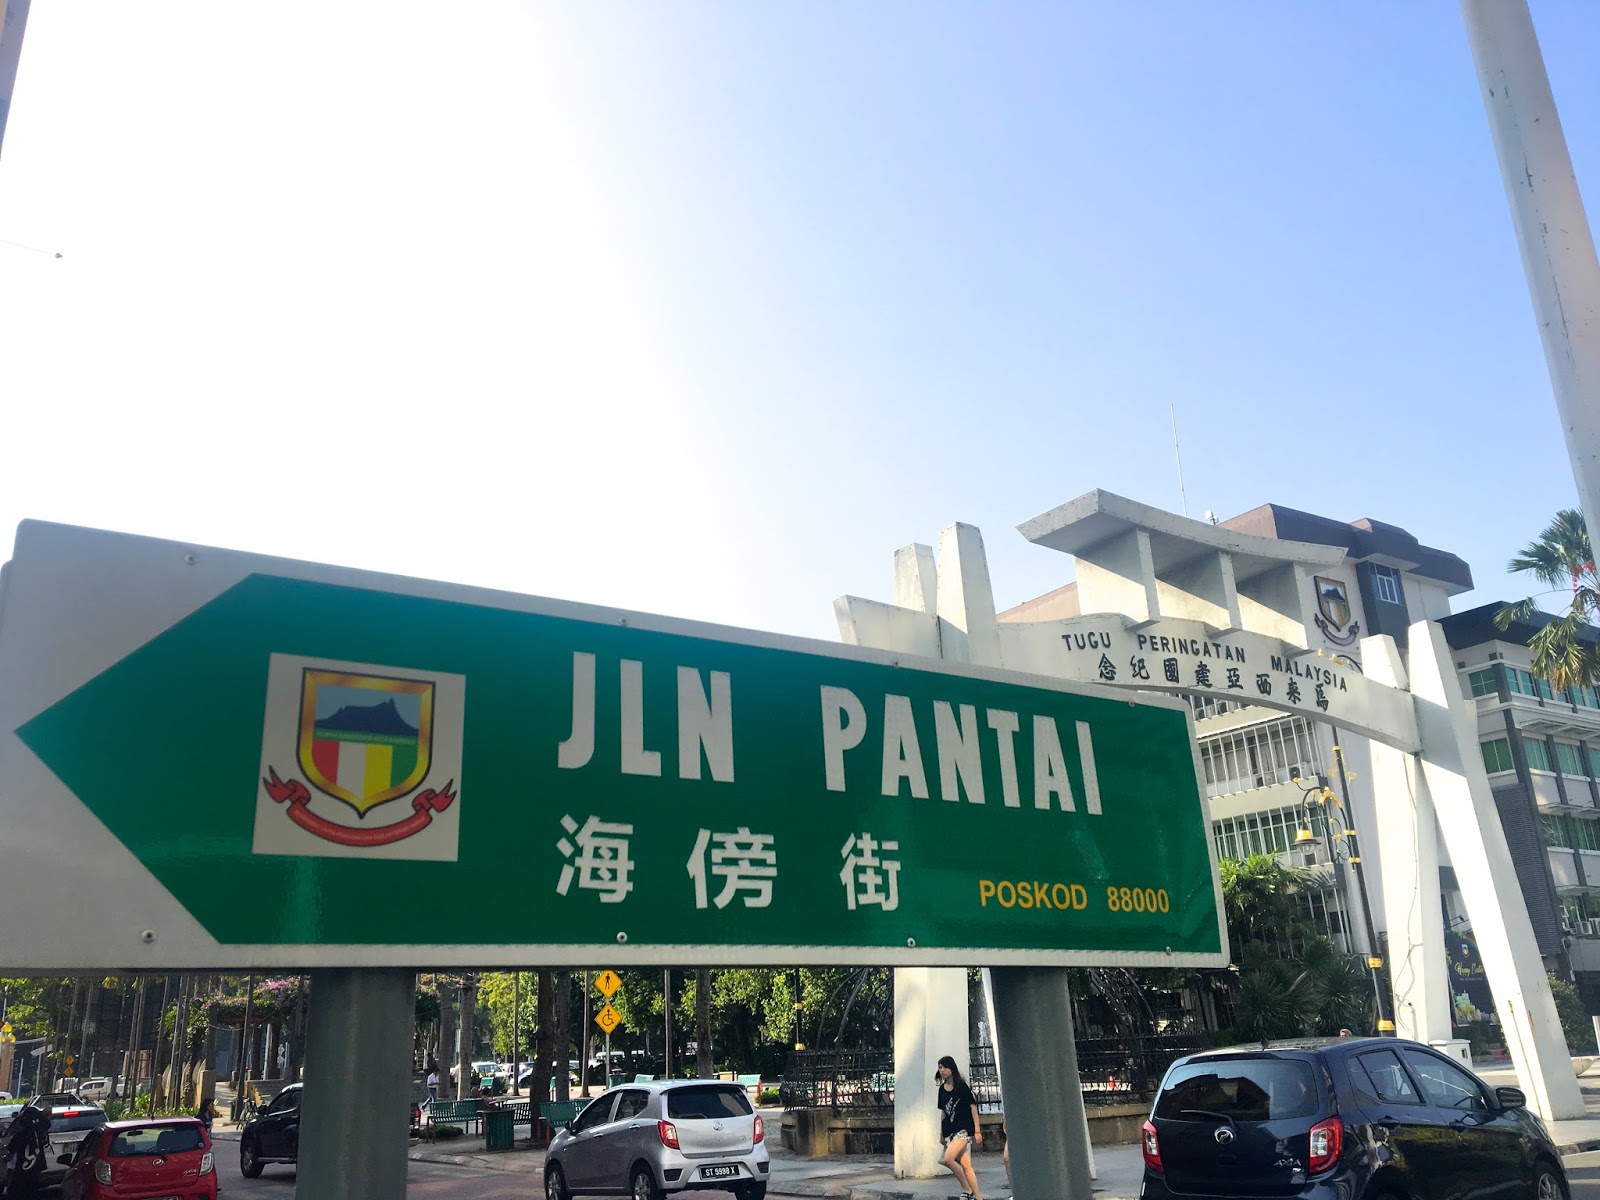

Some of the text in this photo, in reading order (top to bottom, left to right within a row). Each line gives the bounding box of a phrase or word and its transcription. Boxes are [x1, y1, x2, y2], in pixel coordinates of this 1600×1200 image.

[1062, 631, 1348, 693] TUGU PERINGATAN MALAYSIA
[558, 652, 1103, 816] JLN PANTAI
[555, 813, 901, 912] 海傍街
[979, 880, 1171, 914] POSKOD 88000
[705, 1168, 713, 1177] ST
